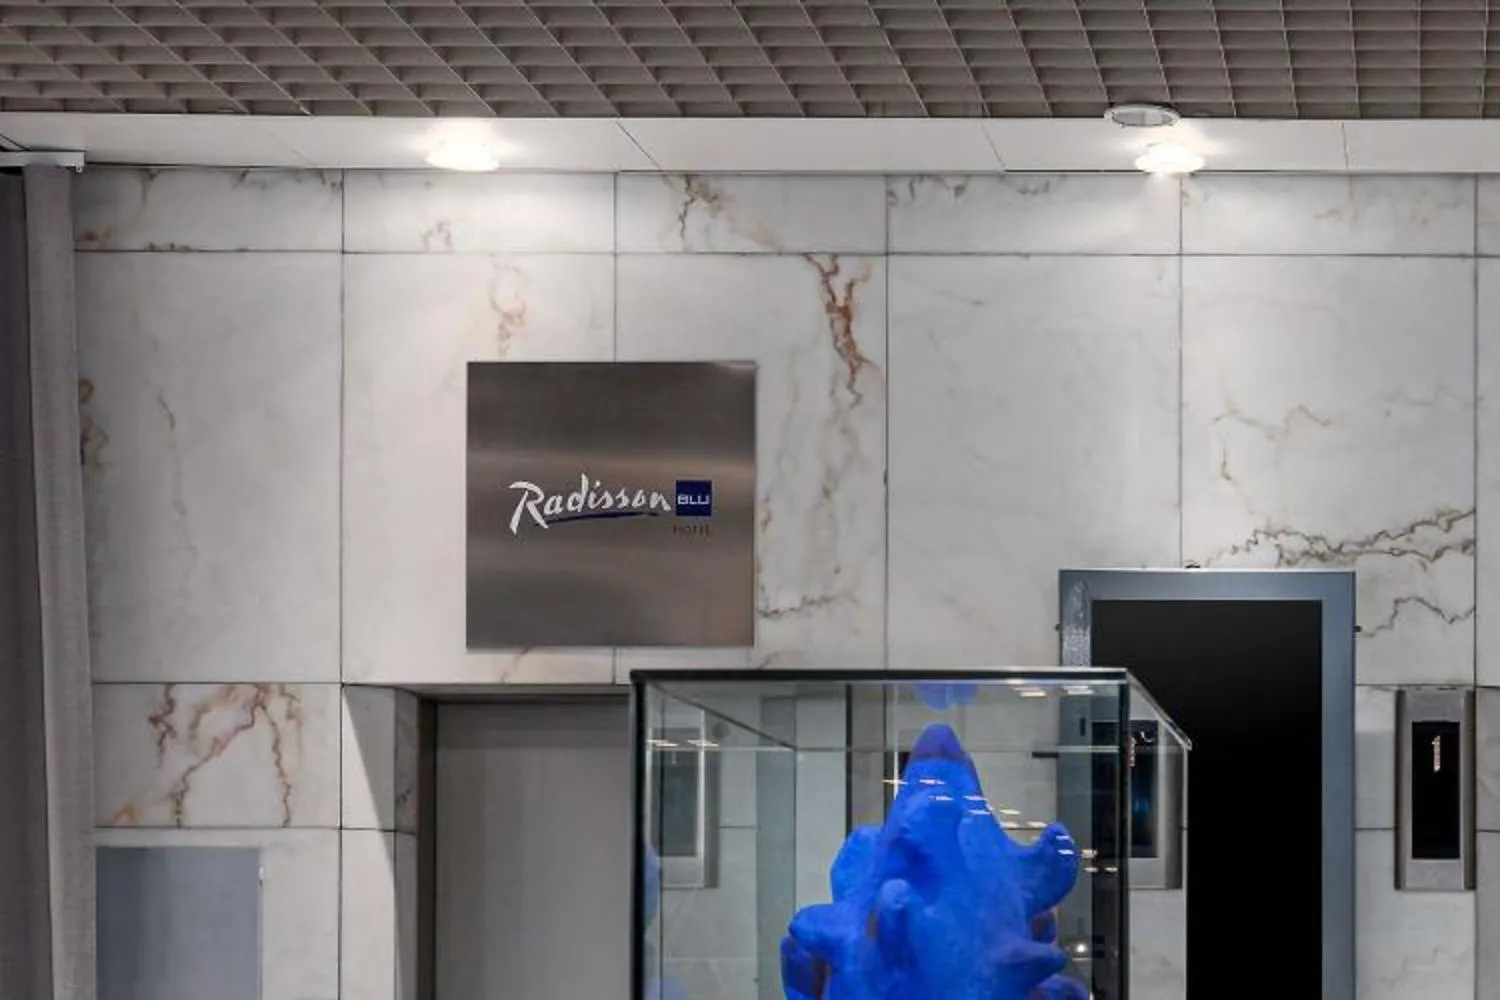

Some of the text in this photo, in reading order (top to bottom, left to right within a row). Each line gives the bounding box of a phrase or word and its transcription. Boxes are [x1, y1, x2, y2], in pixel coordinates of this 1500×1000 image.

[508, 473, 710, 534] Radisson BLU
[1431, 734, 1441, 773] 1
